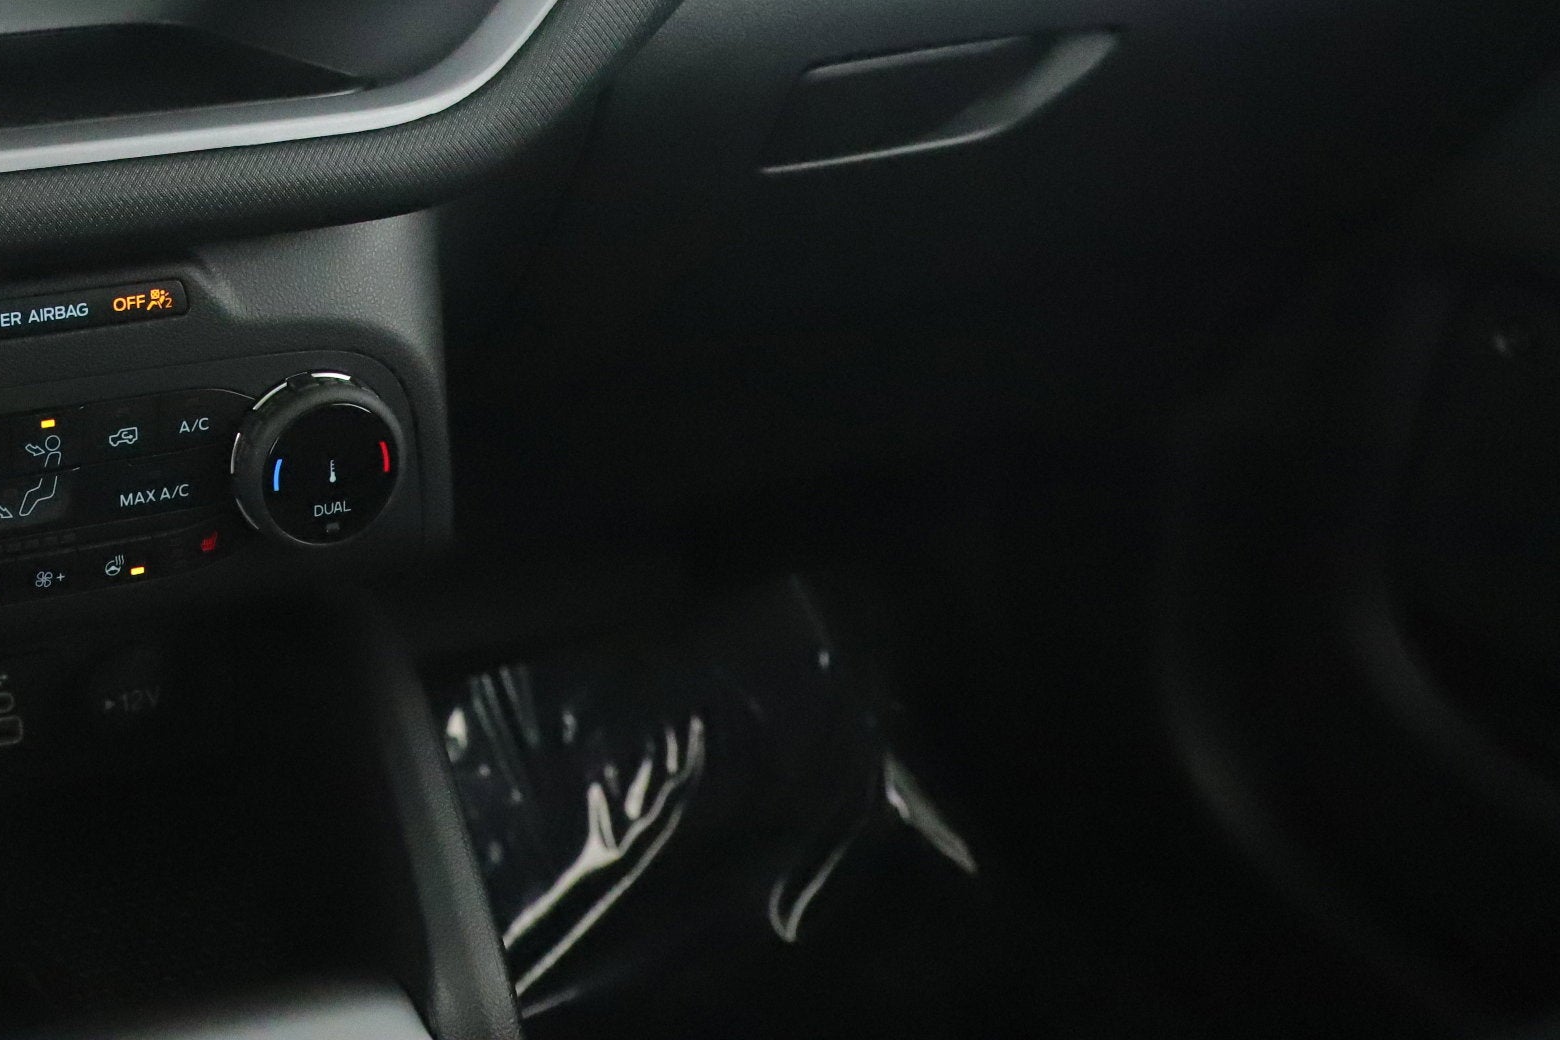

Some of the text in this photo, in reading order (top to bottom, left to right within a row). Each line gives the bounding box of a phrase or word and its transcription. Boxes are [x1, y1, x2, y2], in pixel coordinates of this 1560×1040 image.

[27, 302, 89, 324] AIRBAG
[112, 293, 146, 312] OFF
[178, 417, 210, 435] A/C
[119, 483, 190, 508] MAX A/C
[313, 500, 352, 518] DUAL
